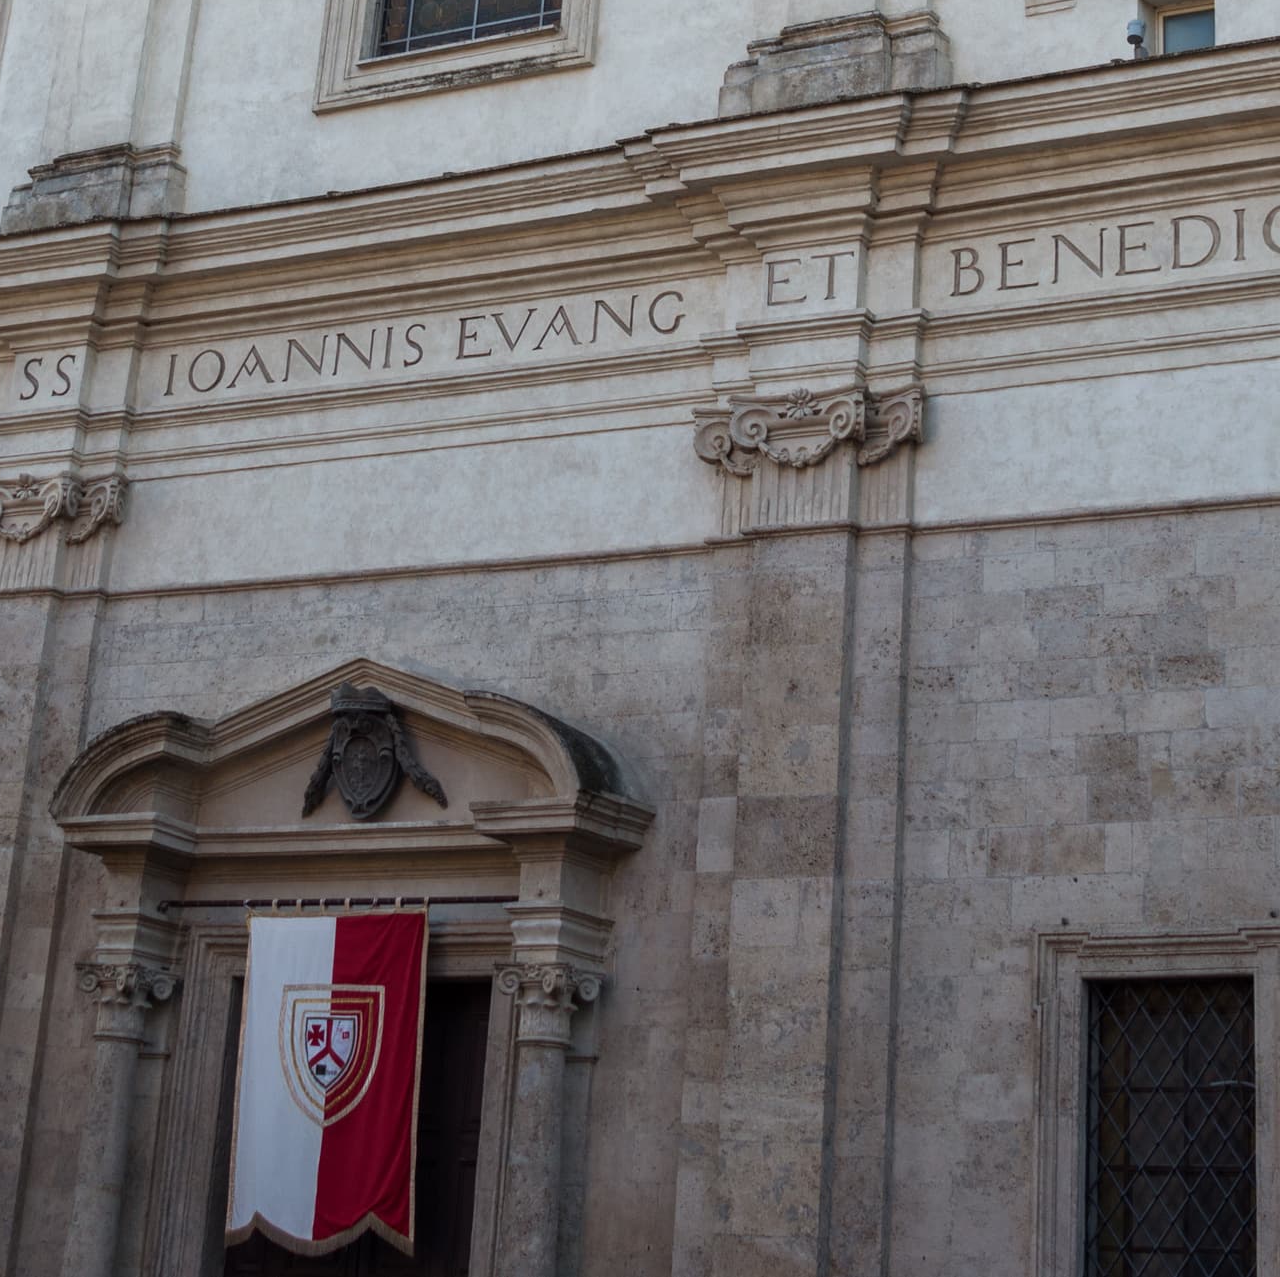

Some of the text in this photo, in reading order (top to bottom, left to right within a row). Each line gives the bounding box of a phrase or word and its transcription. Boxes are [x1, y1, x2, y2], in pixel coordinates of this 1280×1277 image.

[19, 353, 77, 401] SS
[163, 324, 426, 397] IOANNIS
[456, 291, 687, 360] EVANG
[766, 251, 855, 307] ET
